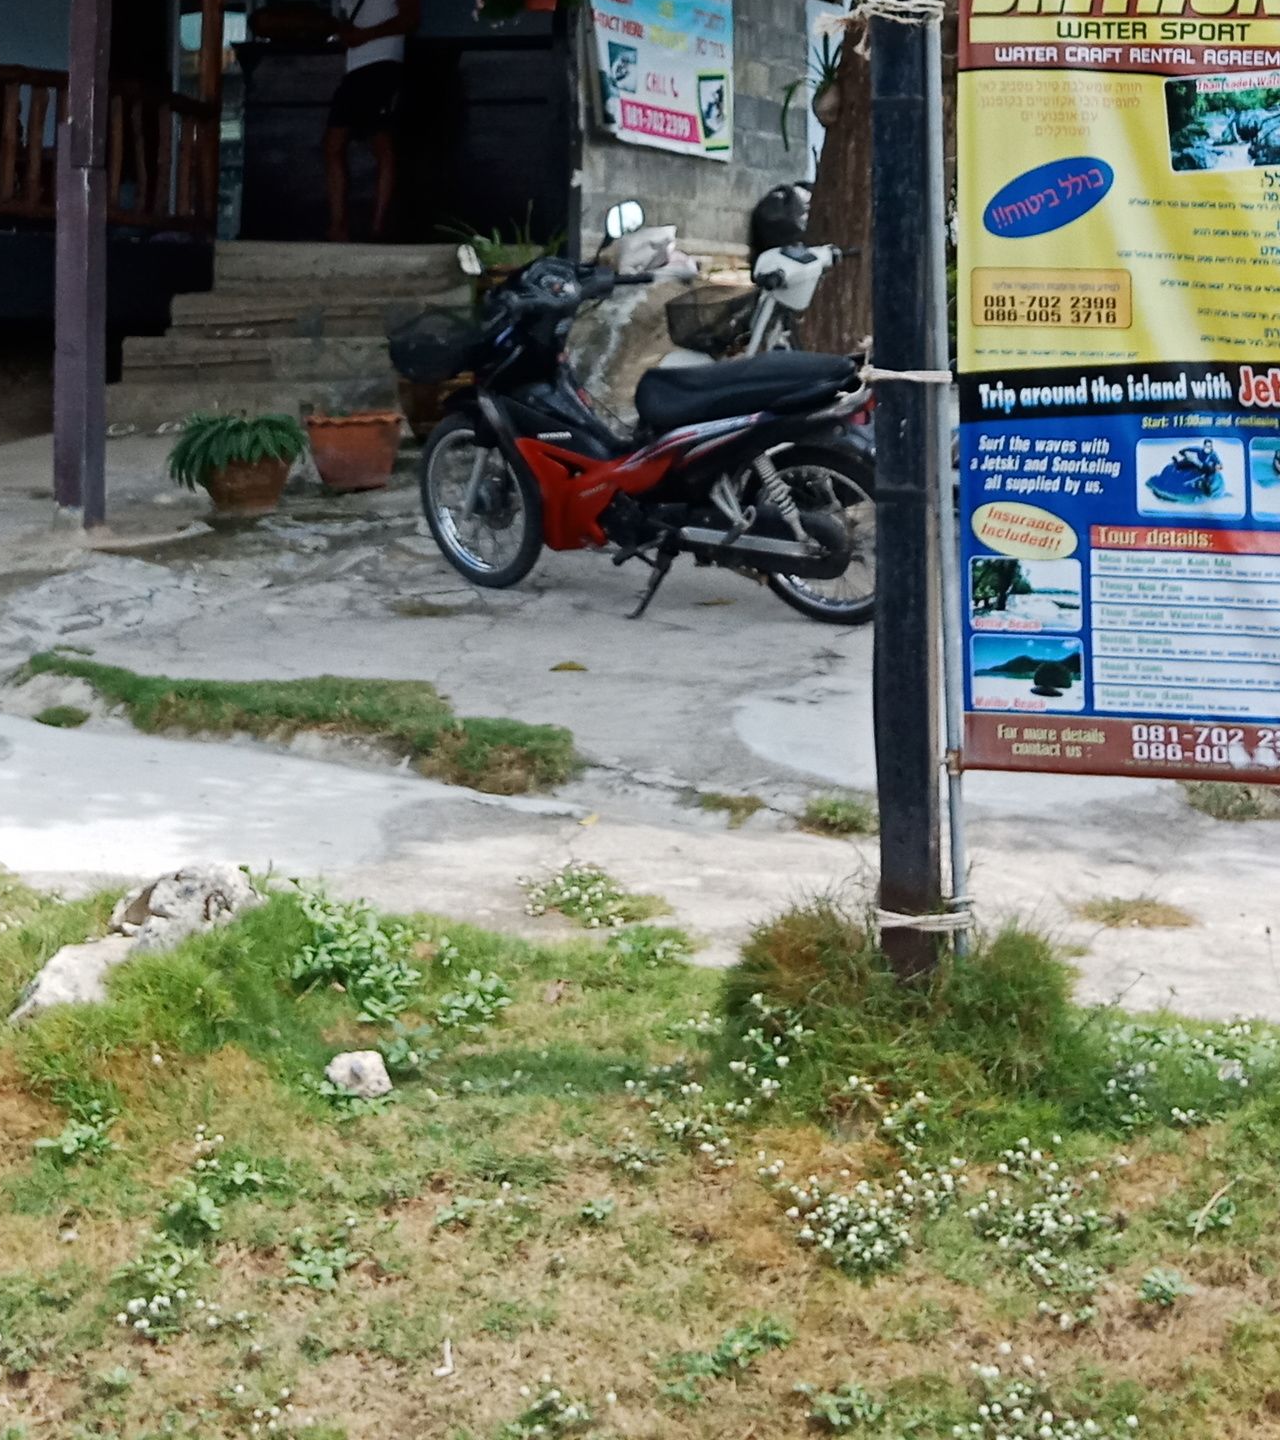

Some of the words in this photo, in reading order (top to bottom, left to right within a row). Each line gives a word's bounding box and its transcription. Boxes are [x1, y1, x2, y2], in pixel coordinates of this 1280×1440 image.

[1056, 21, 1147, 40] WATER
[1161, 23, 1251, 41] SPORT
[995, 46, 1058, 62] WATER
[1066, 47, 1122, 63] CRAFT
[1130, 48, 1196, 65] RENTAL
[1058, 168, 1104, 200] כולל
[992, 188, 1061, 230] ביטוח!!
[984, 295, 1061, 308] 081-702
[979, 383, 1015, 413] Trip
[1021, 376, 1087, 406] around
[1091, 374, 1122, 403] the
[1126, 372, 1188, 402] island
[1191, 370, 1232, 401] with
[1142, 415, 1169, 429] Start:
[1215, 415, 1232, 427] and
[978, 435, 1006, 452] Surf
[1009, 435, 1031, 452] the
[1035, 439, 1077, 454] waves
[1081, 438, 1110, 455] with
[970, 457, 978, 471] a
[980, 454, 1021, 472] Jetski
[1023, 455, 1049, 472] and
[1051, 456, 1122, 478] Snorkeling
[984, 474, 1003, 490] all
[1005, 475, 1062, 495] supplied
[1064, 475, 1081, 496] by
[1084, 480, 1104, 495] us.
[988, 506, 1065, 534] Insurance
[981, 523, 1062, 551] Included!!
[1098, 526, 1138, 546] Tour
[1146, 528, 1214, 548] details:
[1023, 727, 1058, 742] more
[1061, 727, 1106, 745] details
[1131, 724, 1243, 746] 081-702
[1011, 741, 1061, 757] contact
[1065, 745, 1083, 758] us
[1132, 742, 1242, 763] 086-00
